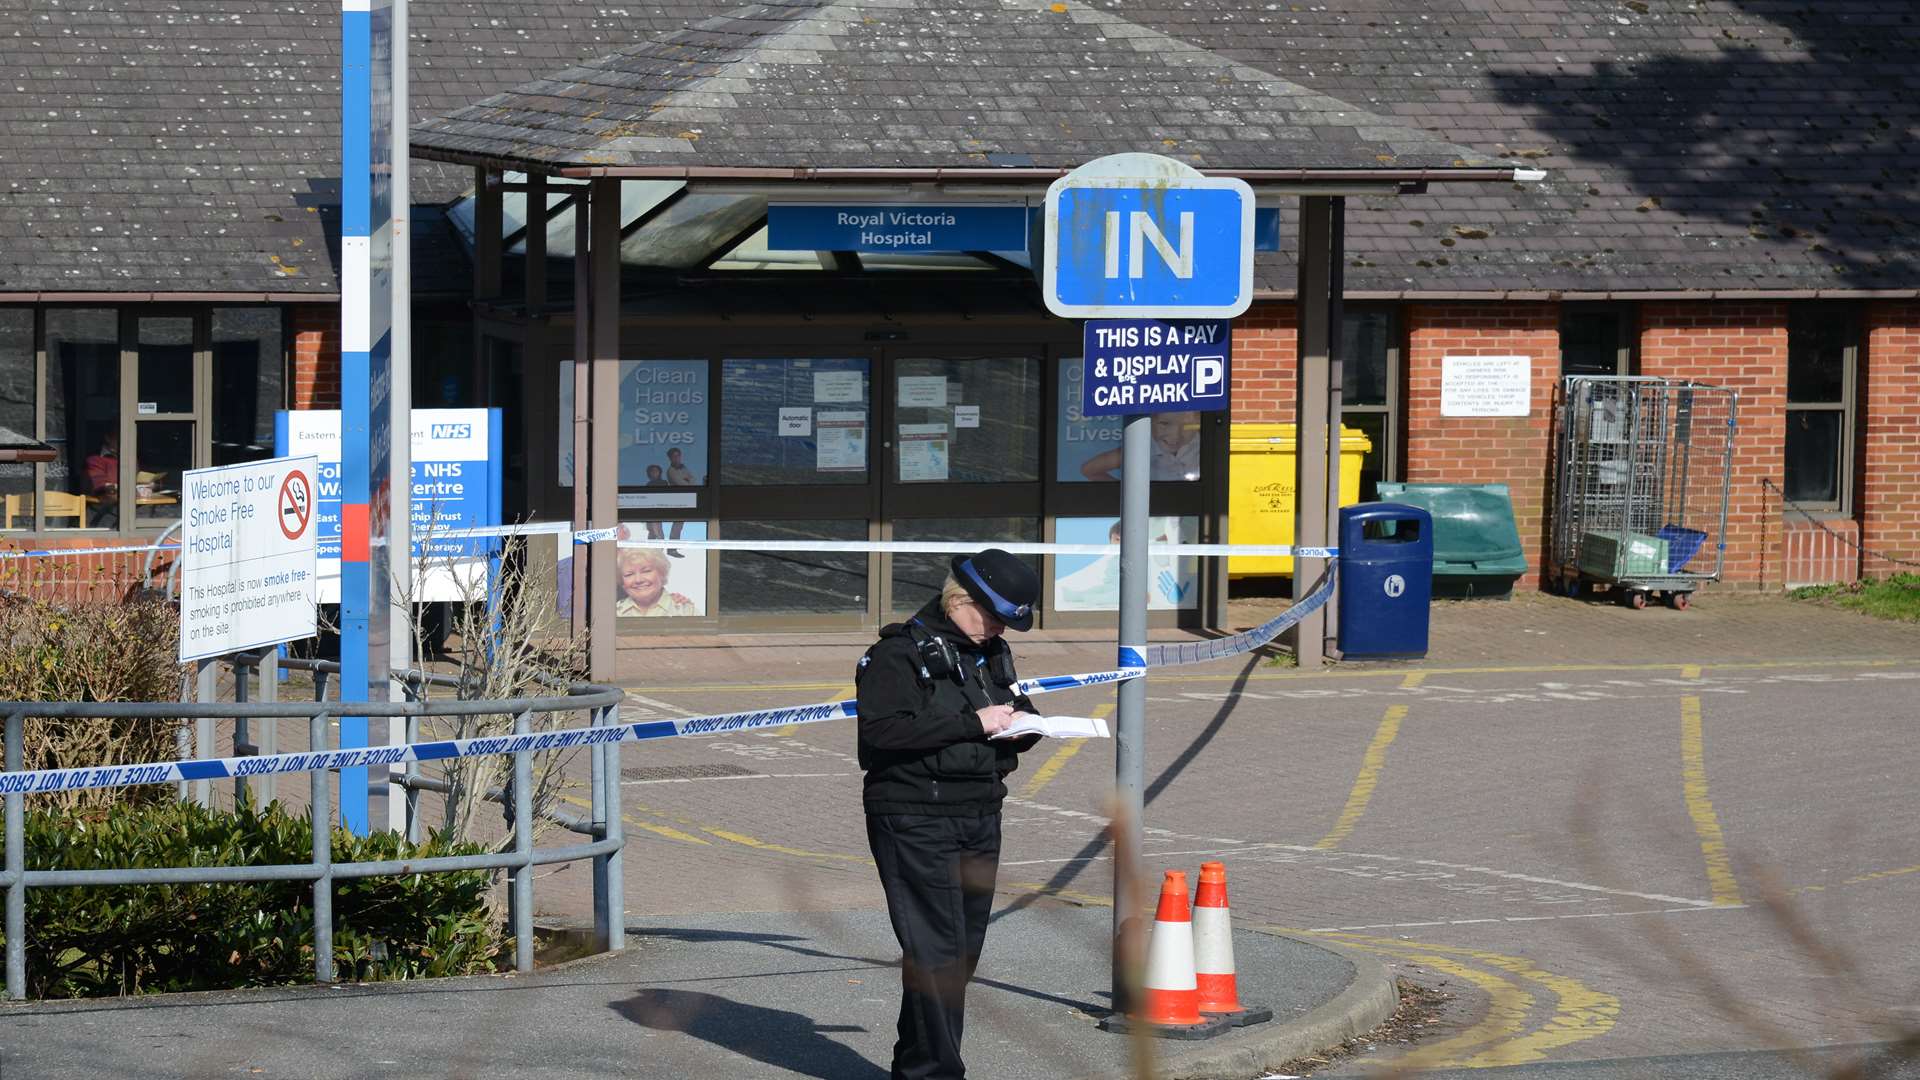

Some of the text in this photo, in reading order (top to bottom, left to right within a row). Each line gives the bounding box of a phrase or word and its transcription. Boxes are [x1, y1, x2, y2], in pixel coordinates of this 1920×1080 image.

[838, 212, 955, 228] Royal Victoria
[861, 231, 932, 247] Hospital
[1105, 211, 1194, 279] IN
[1096, 324, 1218, 348] THIS IS A PAY
[1094, 358, 1107, 377] &
[1113, 354, 1190, 377] DISPLAY
[635, 367, 696, 384] Clean
[635, 387, 703, 404] Hands
[1094, 386, 1134, 406] CAR
[1140, 383, 1189, 403] PARK
[635, 407, 688, 424] Save
[299, 431, 336, 440] Eastern
[432, 424, 470, 438] NHS
[635, 428, 694, 445] Lives
[1066, 425, 1122, 440] Lives
[424, 463, 462, 477] NHS
[190, 474, 275, 500] Welcome to our
[411, 481, 464, 495] entre
[190, 502, 254, 527] Smoke Free
[189, 530, 233, 556] Hospital
[189, 586, 204, 600] This
[207, 580, 236, 598] Hospital
[239, 580, 245, 592] is
[247, 578, 262, 590] now
[264, 572, 289, 587] smoke
[190, 589, 301, 620] smoking is prohibited anywhere
[190, 622, 229, 640] on the site
[681, 705, 838, 734] POLICE LINE DO NOT CROSS
[464, 727, 629, 756] POLICE LINE DO NOT CROSS
[234, 747, 408, 776] POLICE LINE DO NOT CROSS
[35, 773, 67, 791] NOT
[67, 771, 90, 789] DO
[90, 768, 122, 787] LINE
[124, 765, 172, 784] POLICE
